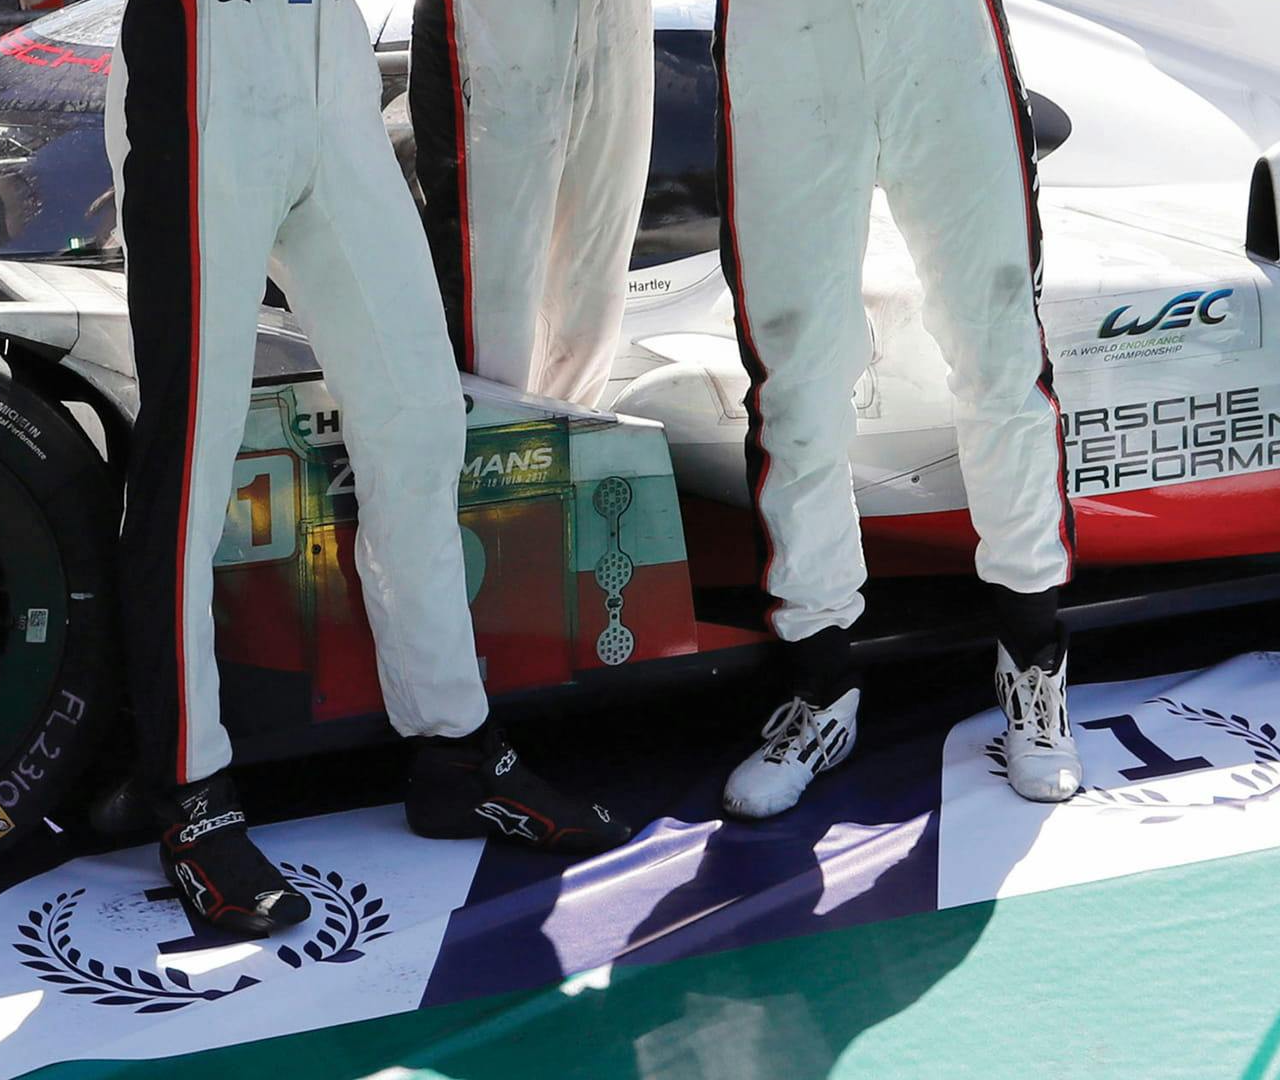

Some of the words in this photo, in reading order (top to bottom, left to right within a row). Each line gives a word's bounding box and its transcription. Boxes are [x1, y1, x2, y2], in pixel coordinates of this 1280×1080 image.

[628, 277, 672, 293] Hartley
[1096, 288, 1234, 339] WEC
[1081, 344, 1118, 356] WORLD
[1119, 334, 1186, 351] ENDURANCE
[1103, 344, 1183, 362] CHAMPIONSHIP
[236, 472, 273, 548] 1
